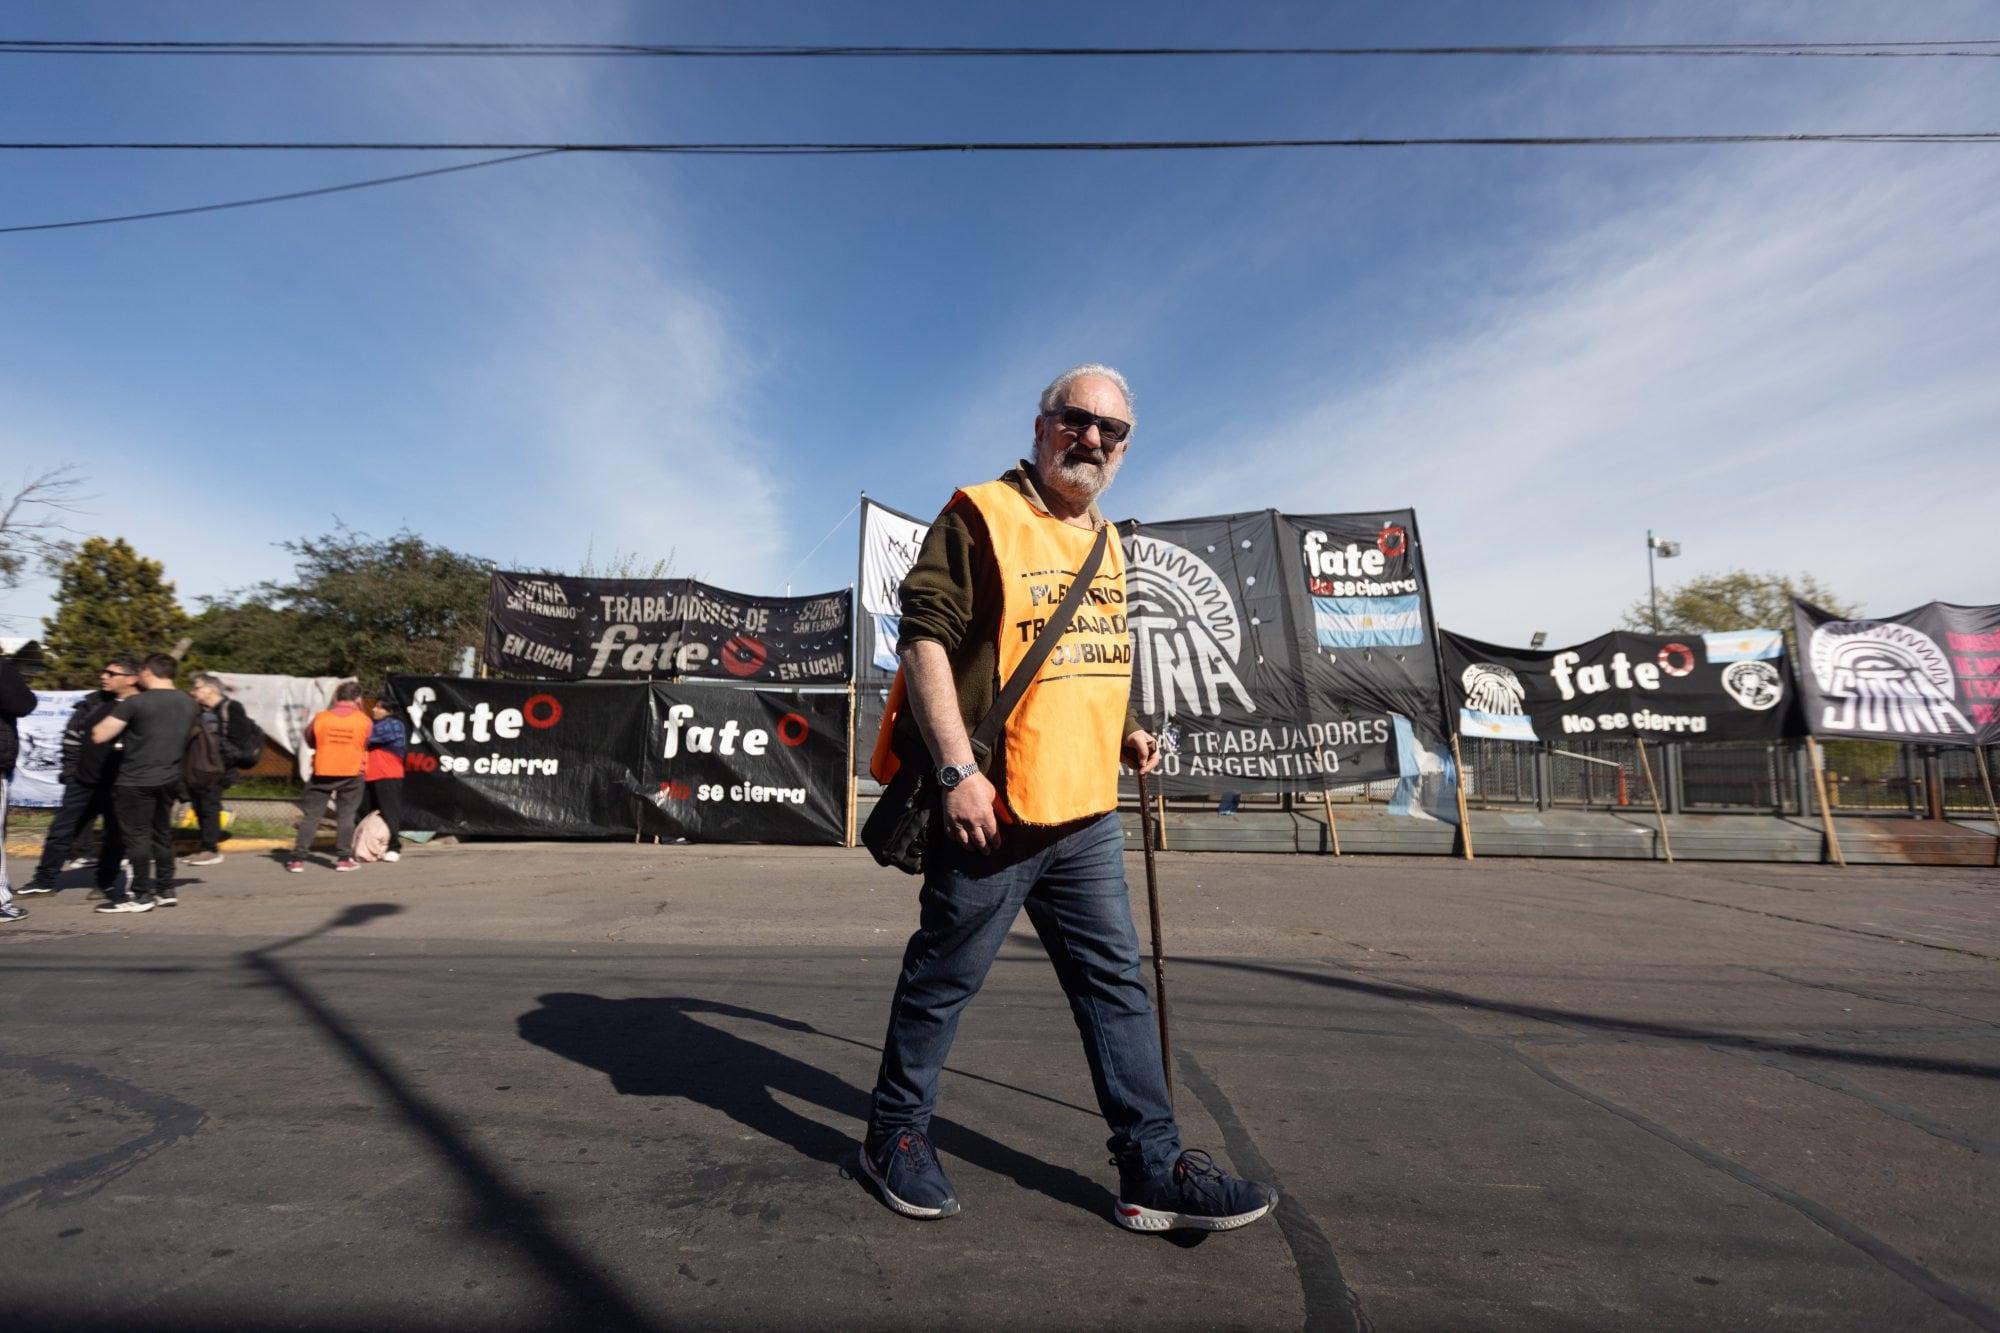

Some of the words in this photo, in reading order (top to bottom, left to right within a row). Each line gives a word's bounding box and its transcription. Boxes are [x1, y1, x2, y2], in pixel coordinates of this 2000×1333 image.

[1030, 584, 1124, 606] PLEARIO
[526, 600, 577, 619] FERNANDO
[600, 595, 740, 629] TRABAJADORES
[745, 608, 770, 633] DE
[793, 621, 811, 634] SAN
[1016, 615, 1128, 642] TRBAJAD
[502, 633, 526, 657] EN
[524, 641, 574, 673] LUCHA
[1050, 643, 1131, 666] JUBILAD
[778, 662, 801, 681] EN
[801, 652, 845, 677] LUCHA
[1562, 714, 1595, 734] No
[1597, 712, 1630, 731] se
[1631, 708, 1707, 733] cierra
[1188, 718, 1389, 754] TRABAJADORES
[405, 752, 437, 772] No
[439, 755, 471, 773] se
[474, 753, 559, 776] cierra
[1189, 749, 1340, 777] ARGENTINO
[697, 784, 725, 801] se
[730, 781, 806, 804] cierra
